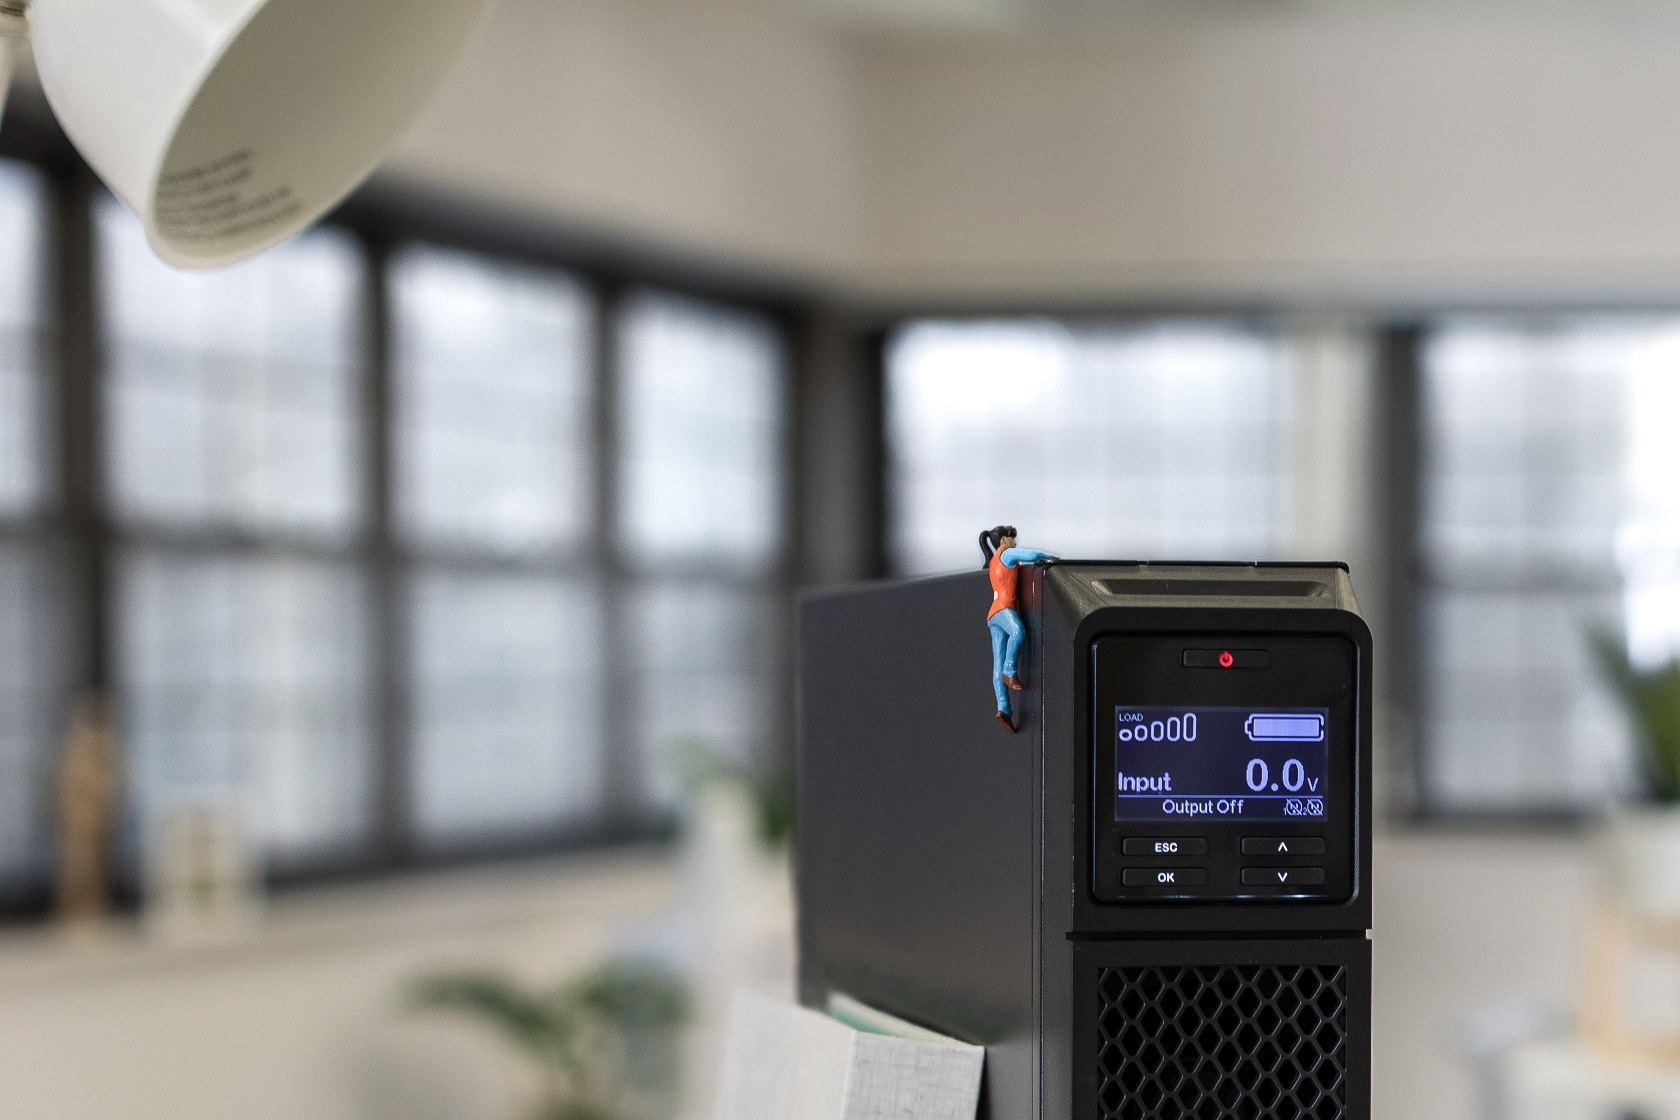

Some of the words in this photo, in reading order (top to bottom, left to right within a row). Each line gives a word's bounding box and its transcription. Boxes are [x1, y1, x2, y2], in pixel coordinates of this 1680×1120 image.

[1118, 713, 1144, 722] LOAD
[1118, 771, 1173, 795] Input
[1246, 758, 1305, 792] 0.0
[1162, 799, 1214, 817] Output
[1216, 799, 1245, 815] Off
[1154, 842, 1178, 853] ESC
[1157, 872, 1175, 883] OK
